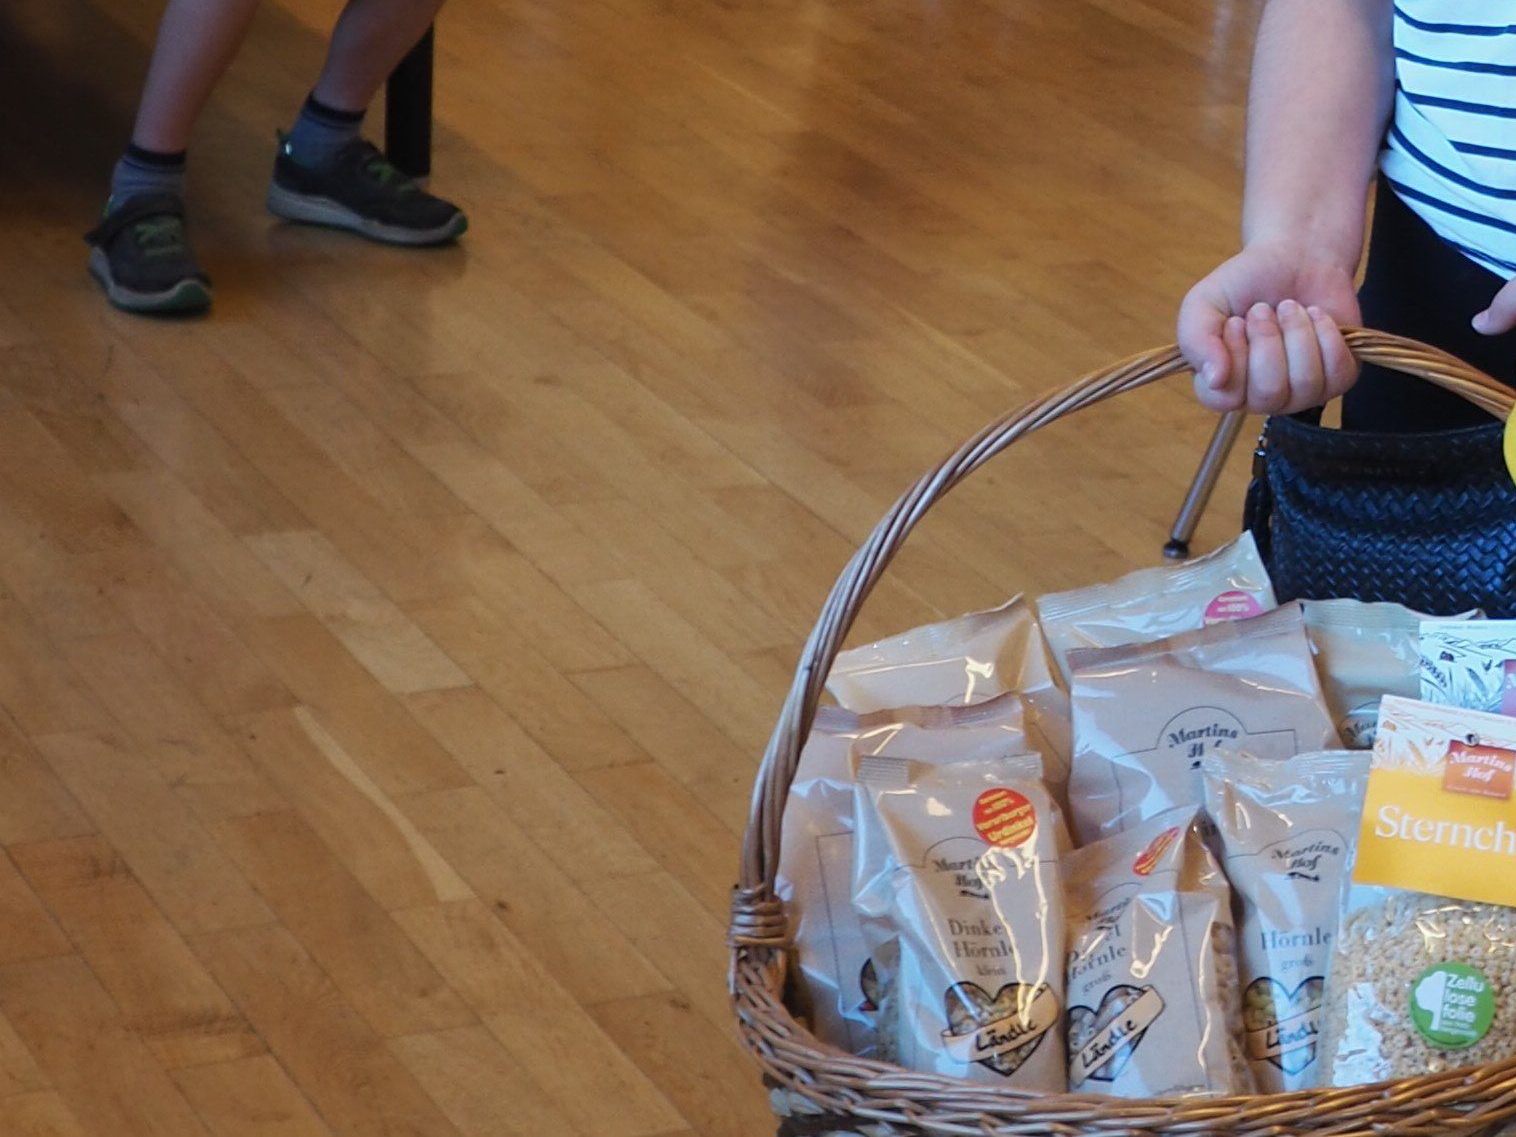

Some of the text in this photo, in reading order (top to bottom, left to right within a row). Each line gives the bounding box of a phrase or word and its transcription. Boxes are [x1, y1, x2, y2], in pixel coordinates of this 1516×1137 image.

[1168, 723, 1239, 748] Martins
[1450, 749, 1514, 773] Martins
[1462, 765, 1497, 783] Hof
[1271, 841, 1340, 860] Martins
[1290, 853, 1322, 871] Hof
[948, 918, 1003, 936] Dinke
[1261, 927, 1332, 951] Hörnle
